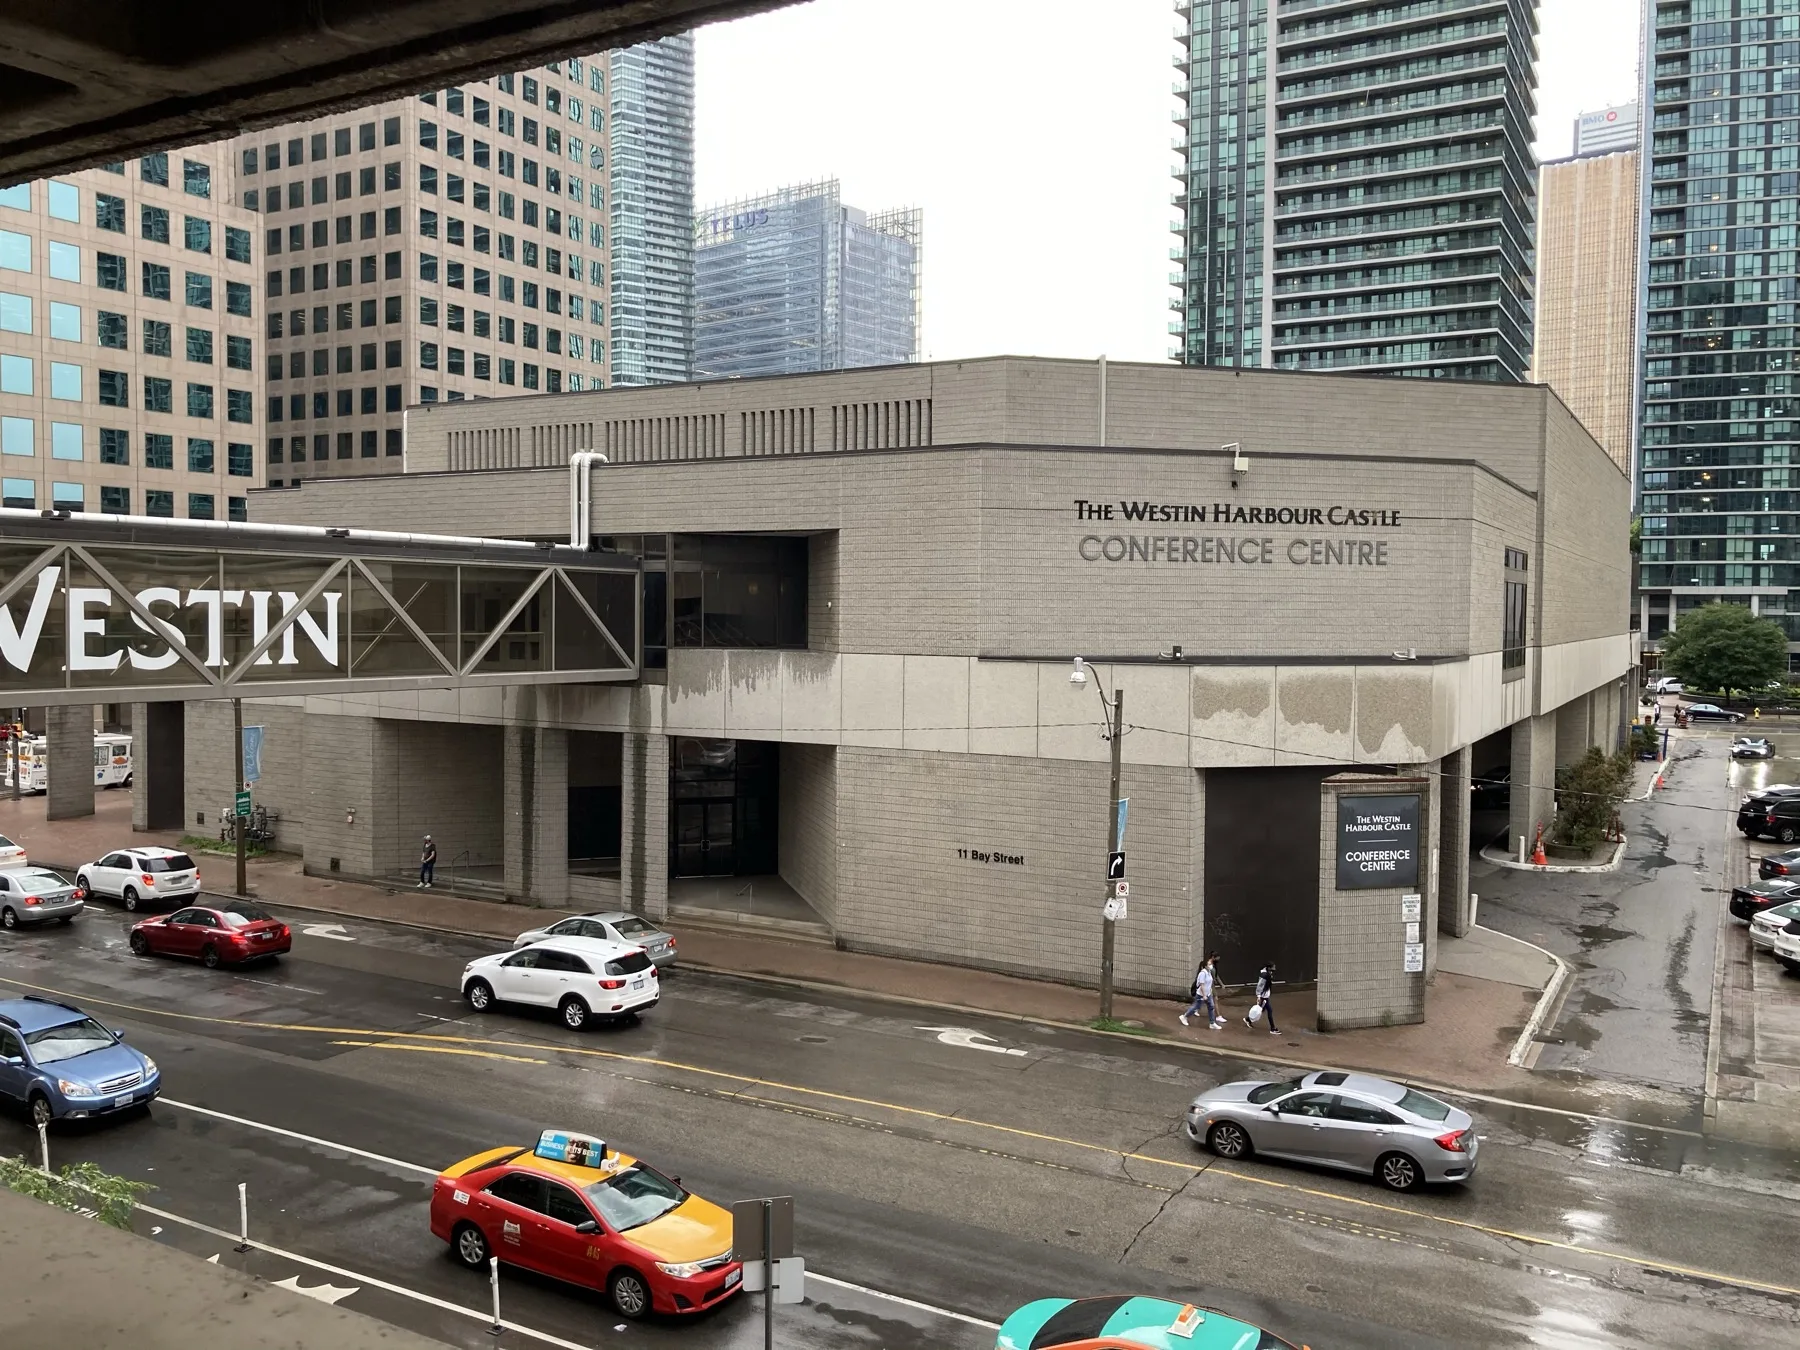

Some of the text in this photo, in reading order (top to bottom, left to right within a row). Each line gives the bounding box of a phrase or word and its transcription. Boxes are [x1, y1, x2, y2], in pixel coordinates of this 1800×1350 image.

[711, 208, 768, 235] TELUS
[1074, 500, 1402, 527] THE WESTIN HARBOUR CASTLE
[1078, 534, 1388, 566] CONFERENCE CENTRE
[1345, 823, 1411, 832] HARBOUR CASTLE
[1356, 815, 1401, 824] THE WESTIN
[957, 849, 1024, 865] 11 Bay Street
[1345, 850, 1410, 872] CONFERENCE CENTRE
[582, 1148, 599, 1157] BEST
